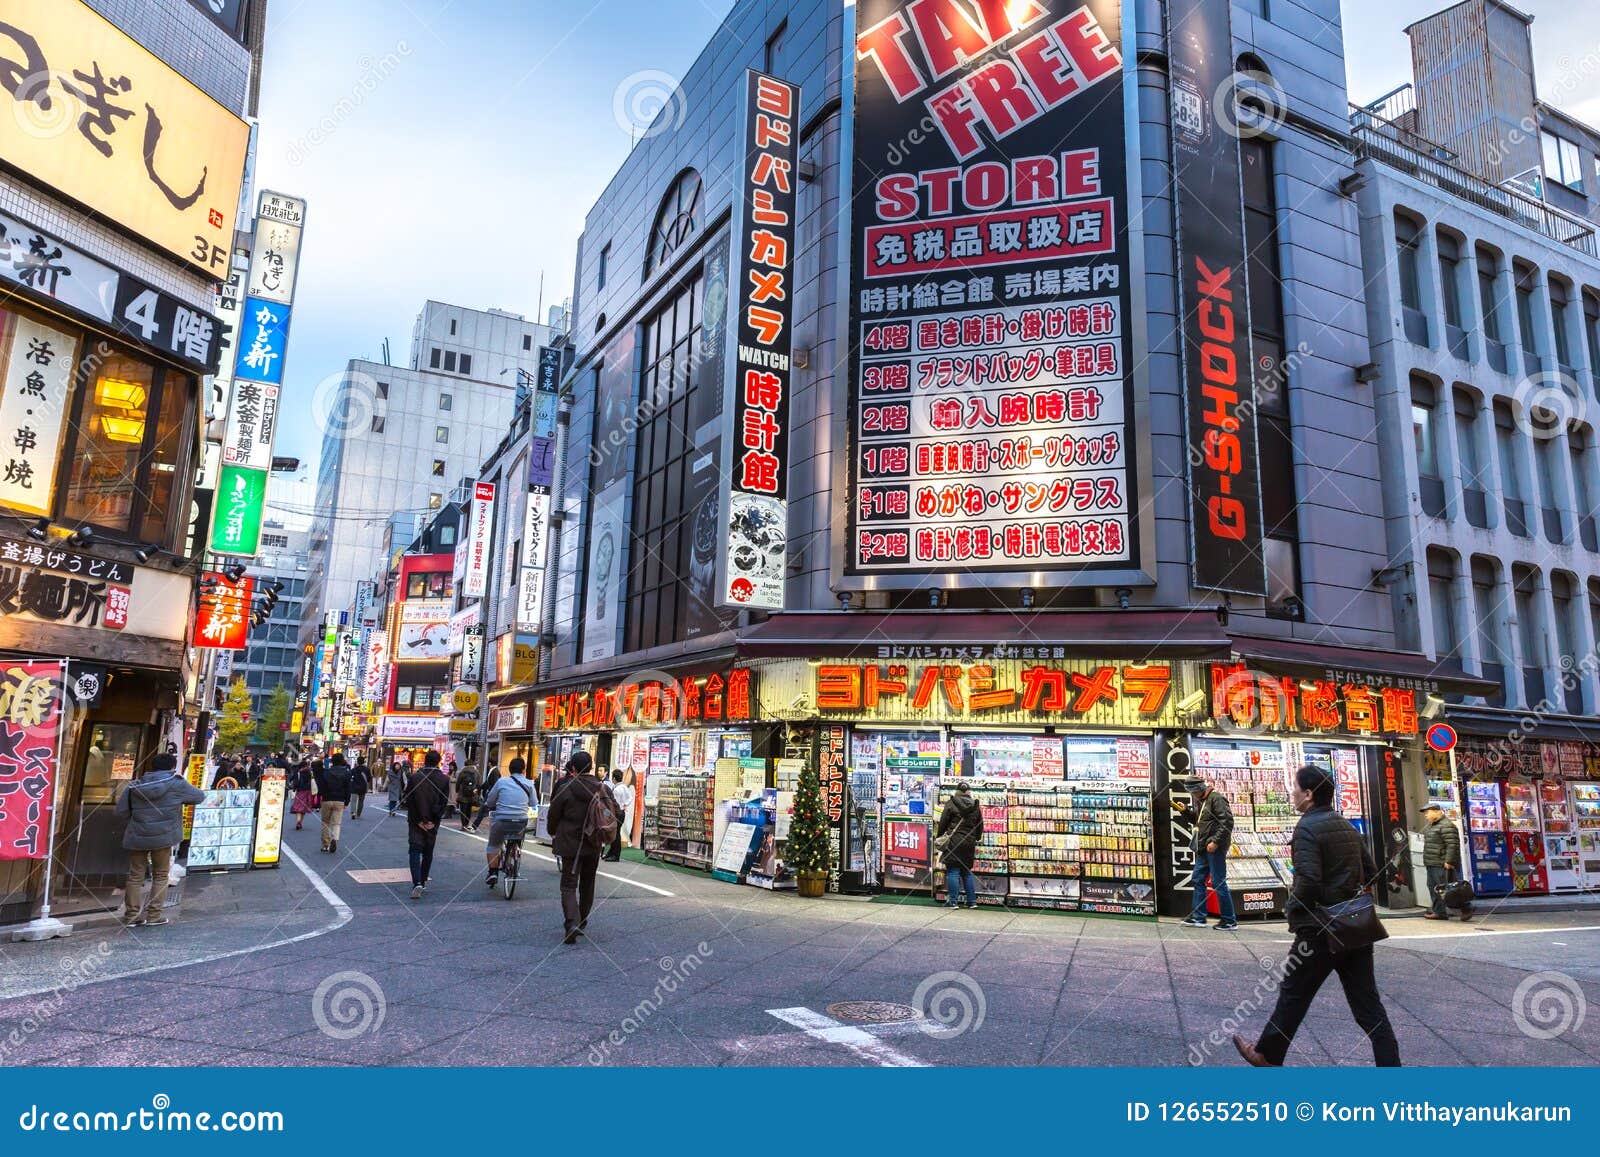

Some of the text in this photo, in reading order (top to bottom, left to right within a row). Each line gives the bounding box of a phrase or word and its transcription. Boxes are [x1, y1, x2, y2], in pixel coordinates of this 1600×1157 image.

[924, 4, 1123, 164] FREE
[875, 147, 1101, 222] STORE
[748, 76, 792, 345] ヨドバシカメラ
[191, 235, 227, 269] 3F
[874, 211, 1104, 267] 免税品取扱店
[263, 249, 284, 291] ねぎし
[860, 262, 1120, 313] 時計総合館 売場案内
[125, 288, 212, 366] 4階
[243, 306, 279, 375] かど新
[865, 302, 1115, 350] 4階 置き時計・掛け時計
[739, 344, 789, 371] WATCH
[864, 344, 1116, 391] 3階 ブランドバッグ・筆記具
[4, 337, 55, 489] 活魚・串焼
[863, 389, 1102, 432] 2階 輸入腕時計
[1195, 254, 1247, 541] G-SHOCK
[235, 384, 262, 464] 楽釜製麺所
[740, 369, 782, 494] 時計館
[864, 432, 1121, 475] 1階 国産腕時計・スポーツウォッチ
[534, 486, 545, 494] 2F
[915, 477, 1121, 517] めがね・サングラス
[1, 541, 123, 580] 釜揚げうどん
[915, 519, 1124, 562] 時計修理・時計電池交換
[525, 571, 539, 622] 新宿カレー
[368, 643, 384, 687] ラーメン
[515, 649, 536, 659] BLG
[878, 646, 983, 659] ヨドバシカメラ
[454, 694, 471, 703] BLG
[817, 665, 1170, 713] ヨドバシカメラ
[1211, 662, 1419, 734] 時計総合館
[1325, 670, 1393, 686] ヨドバシカメラ
[829, 727, 843, 822] ヨドバシカメラ
[1384, 751, 1399, 822] G-SHOCK
